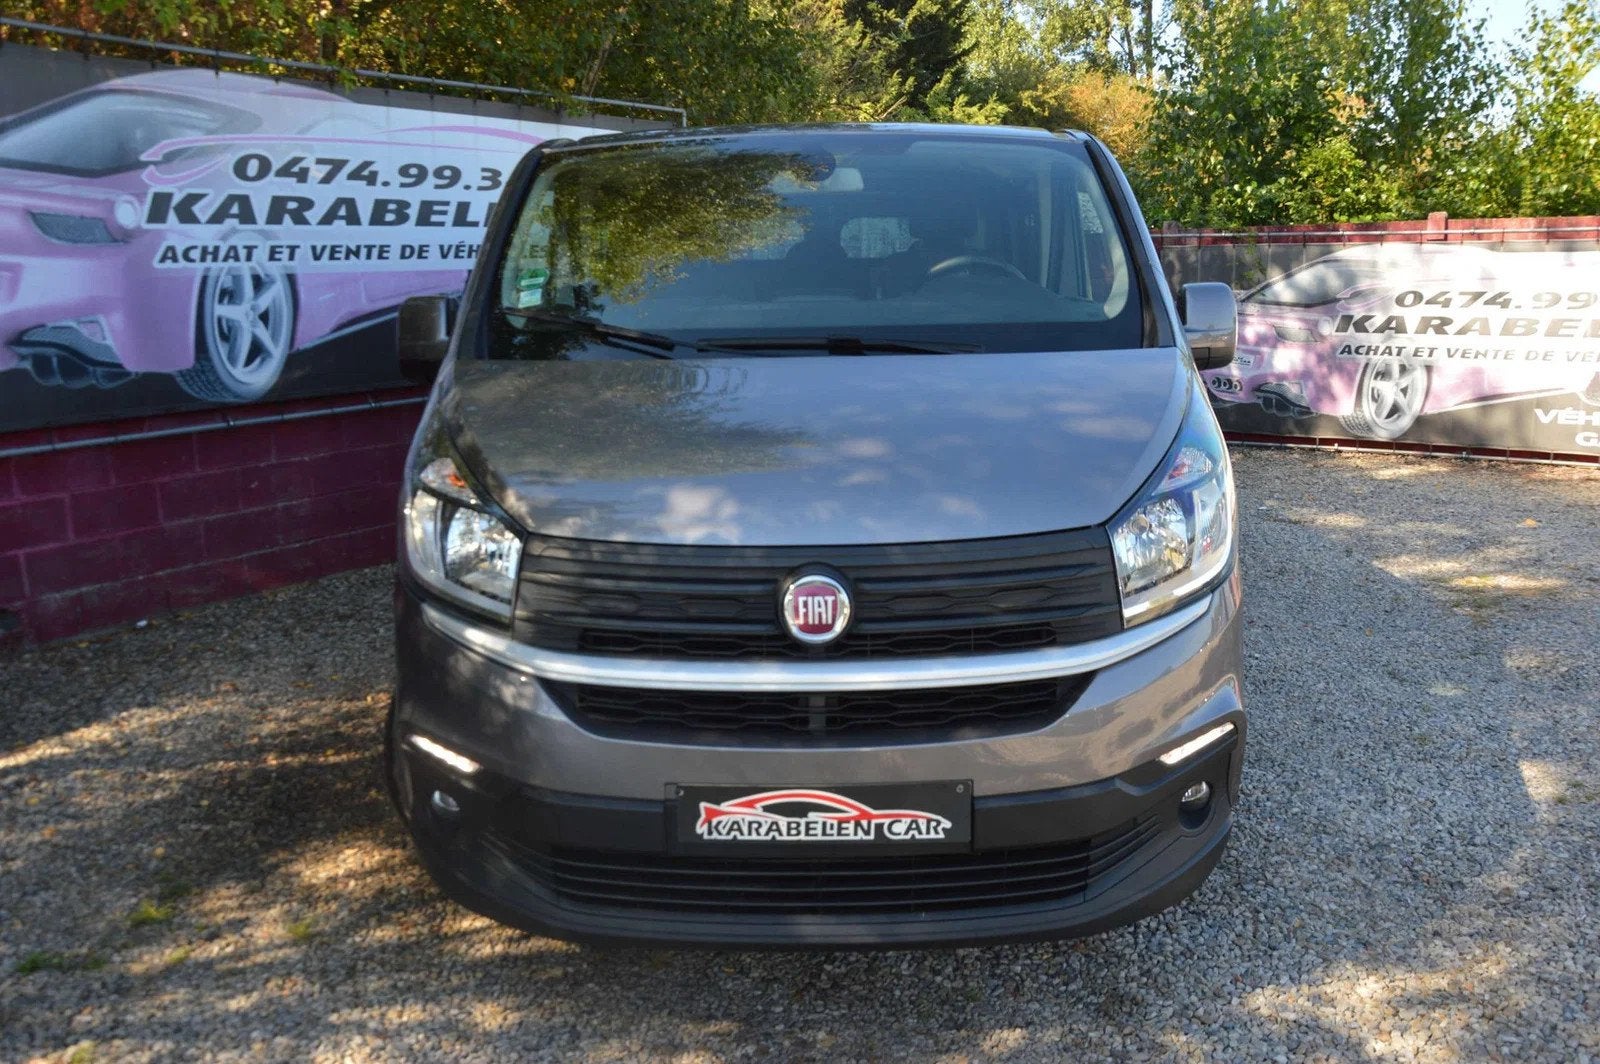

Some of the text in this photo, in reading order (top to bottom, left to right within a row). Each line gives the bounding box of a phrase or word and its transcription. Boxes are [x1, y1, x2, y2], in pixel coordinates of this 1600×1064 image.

[232, 153, 503, 191] 0474.99.3
[145, 192, 499, 228] KARABEL
[158, 244, 258, 264] ACHAT
[268, 244, 301, 262] ET
[310, 244, 391, 262] VENTE
[400, 244, 430, 260] DE
[1340, 344, 1406, 357] ACHAT
[1412, 346, 1438, 358] ET
[1446, 347, 1516, 360] VENTE
[1525, 350, 1555, 361] DE
[797, 595, 836, 625] FIAT
[706, 818, 941, 838] KARABELEN CAR
